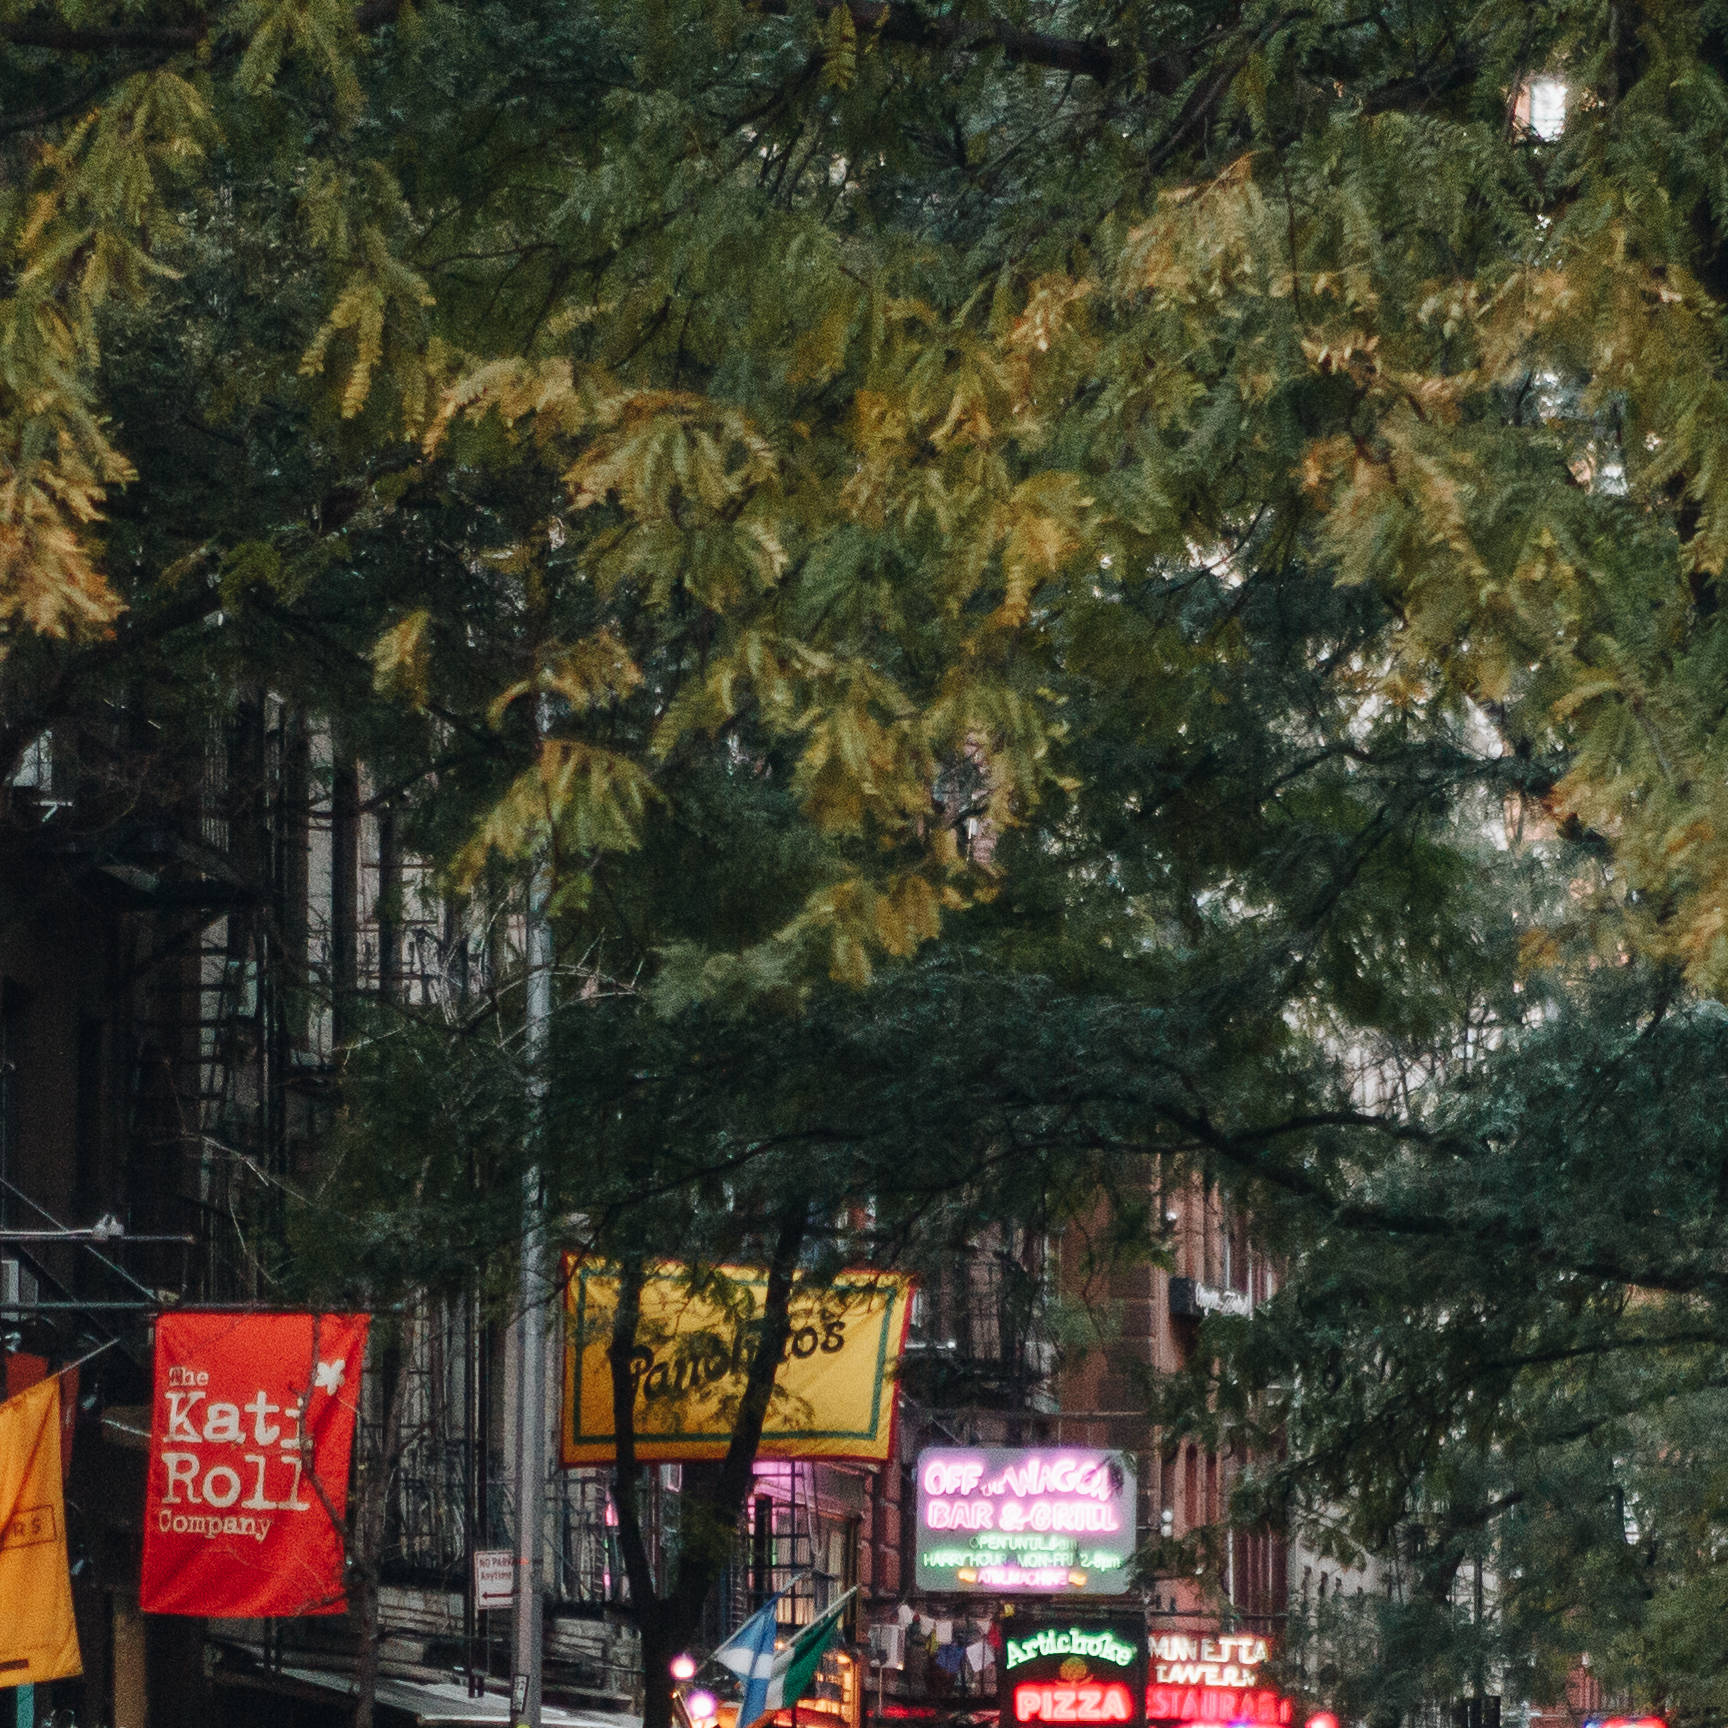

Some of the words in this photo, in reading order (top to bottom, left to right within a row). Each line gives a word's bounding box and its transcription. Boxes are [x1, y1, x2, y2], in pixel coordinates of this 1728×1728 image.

[169, 1366, 209, 1387] The
[163, 1390, 311, 1448] Kati
[161, 1453, 311, 1512] Roll
[924, 1459, 985, 1497] OFF
[158, 1508, 273, 1542] Company
[927, 1500, 994, 1530] BAR
[999, 1502, 1028, 1532] &
[1030, 1501, 1120, 1532] GRILL
[1007, 1627, 1133, 1669] Artichoke
[1015, 1688, 1128, 1721] PIZZA
